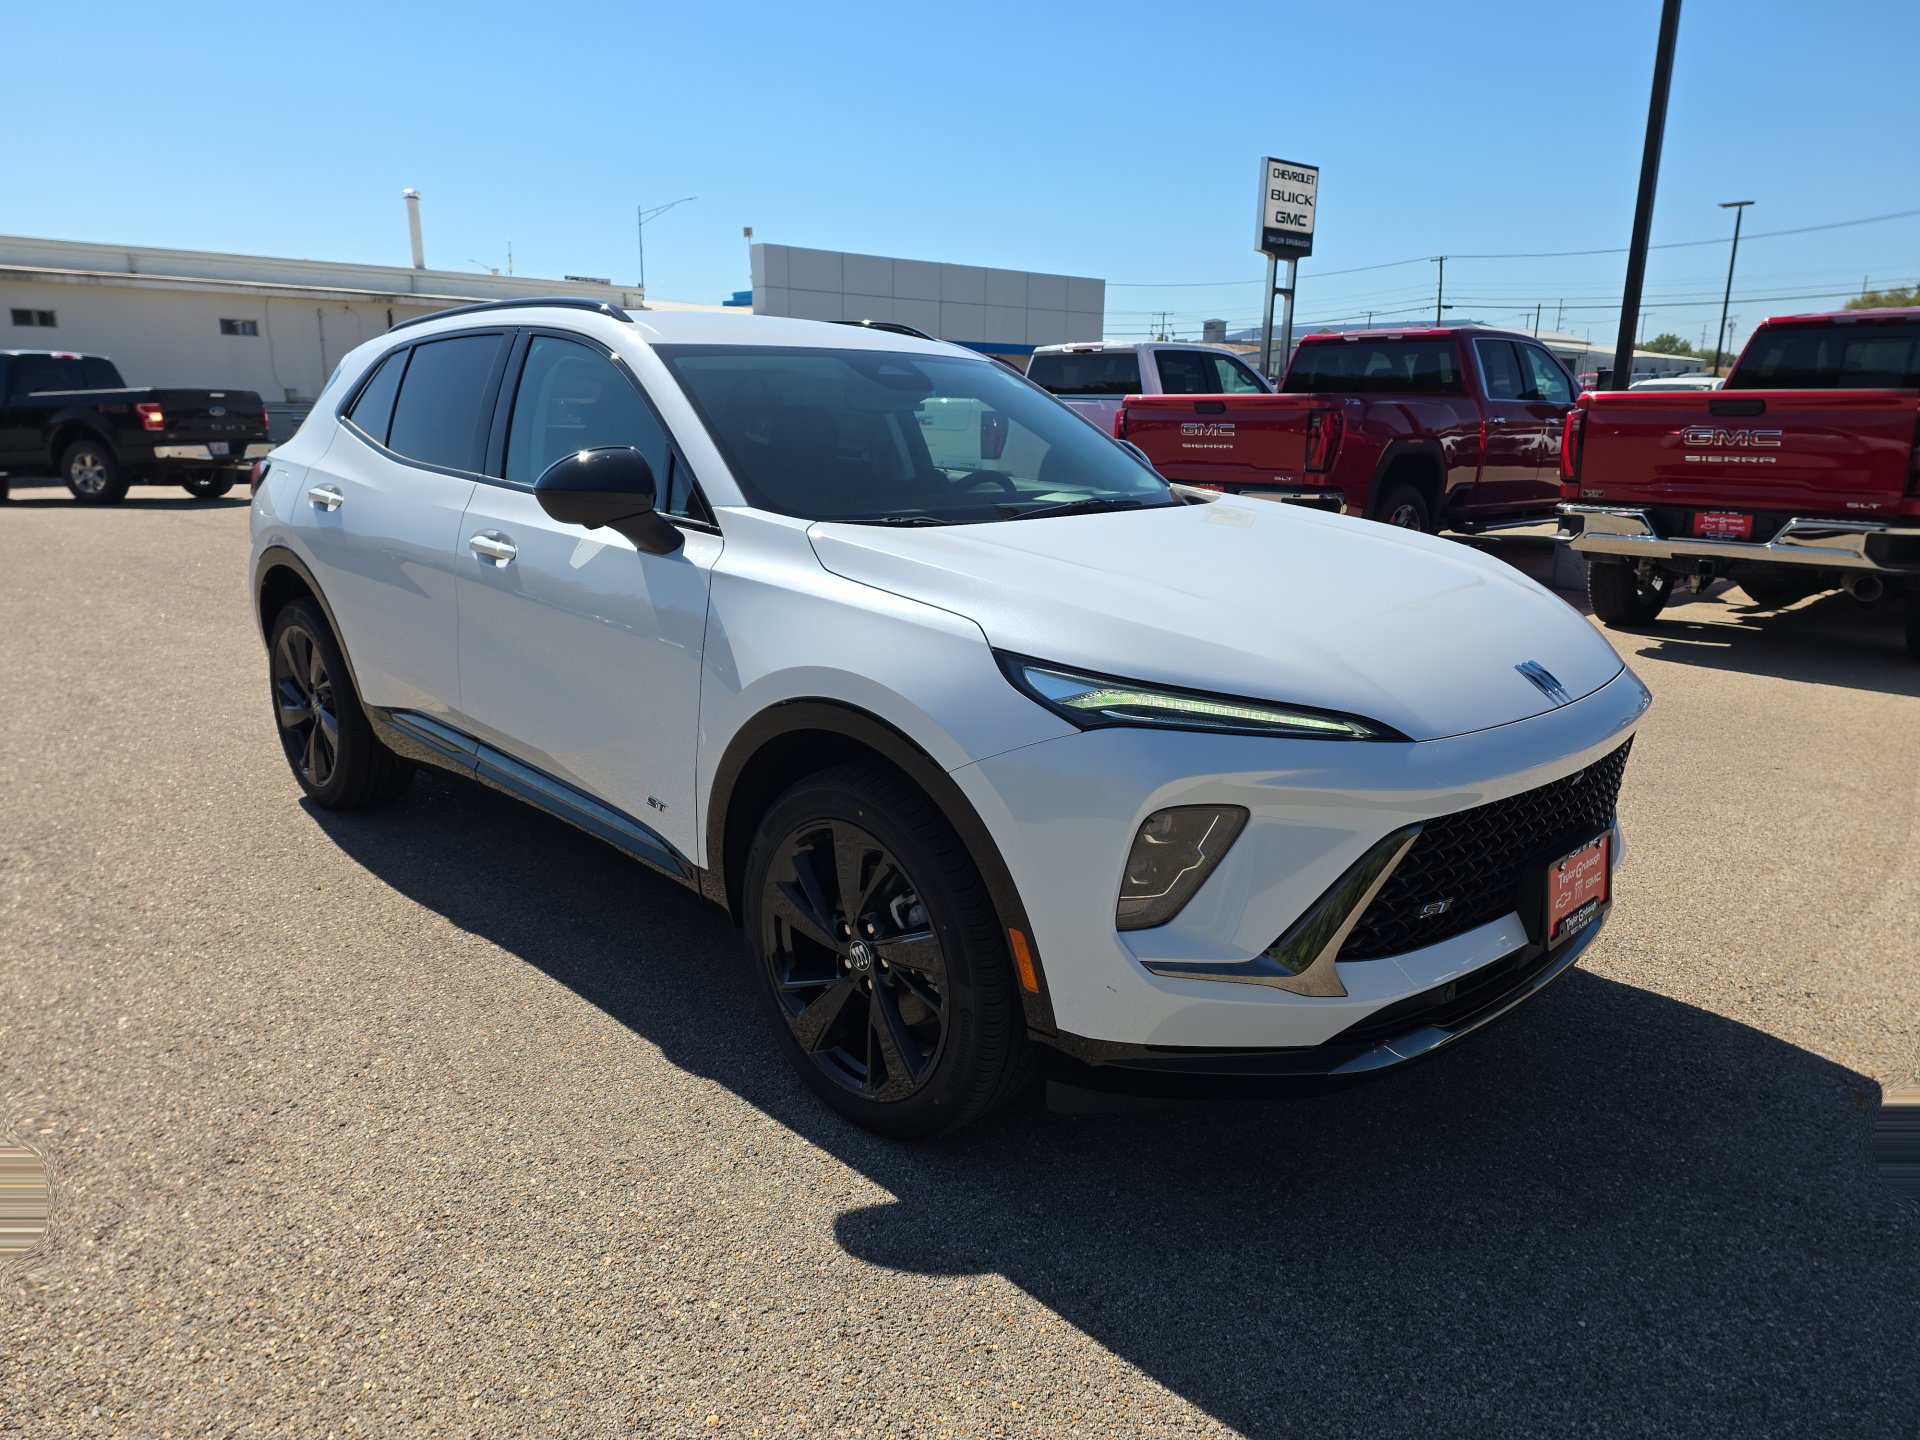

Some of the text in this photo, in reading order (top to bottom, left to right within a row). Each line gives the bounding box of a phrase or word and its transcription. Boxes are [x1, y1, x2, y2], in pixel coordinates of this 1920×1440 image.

[1273, 168, 1315, 185] CHEVROLET
[1271, 189, 1313, 207] BUICK
[1275, 211, 1307, 227] GMC
[1181, 423, 1236, 437] GMC
[1683, 428, 1783, 447] GMC
[1685, 455, 1777, 463] SIERRA
[647, 796, 668, 812] ST
[1558, 853, 1601, 889] Taylor Grubaugh
[1585, 872, 1602, 889] GMC
[1420, 898, 1454, 918] ST
[1565, 914, 1579, 931] Taylor
